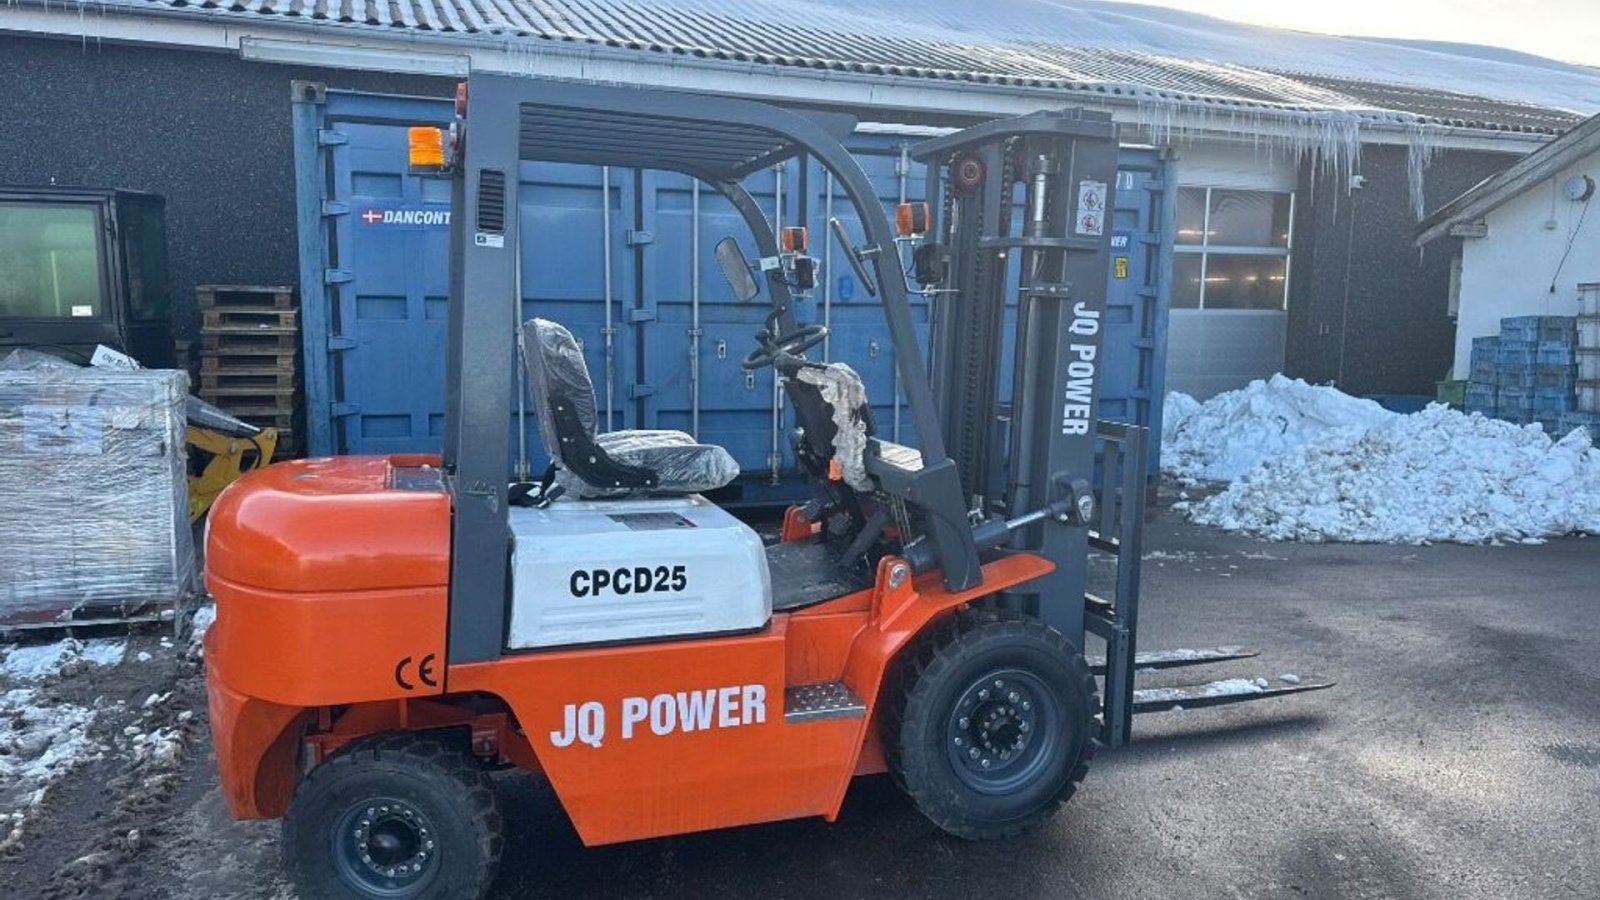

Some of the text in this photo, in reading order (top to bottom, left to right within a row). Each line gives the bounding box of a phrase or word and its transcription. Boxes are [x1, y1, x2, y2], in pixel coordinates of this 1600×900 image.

[383, 210, 451, 225] DANCONT
[1062, 301, 1100, 435] JQ POWER
[569, 565, 688, 598] CPCD25
[395, 653, 437, 690] CE
[550, 684, 766, 748] JQ POWER
